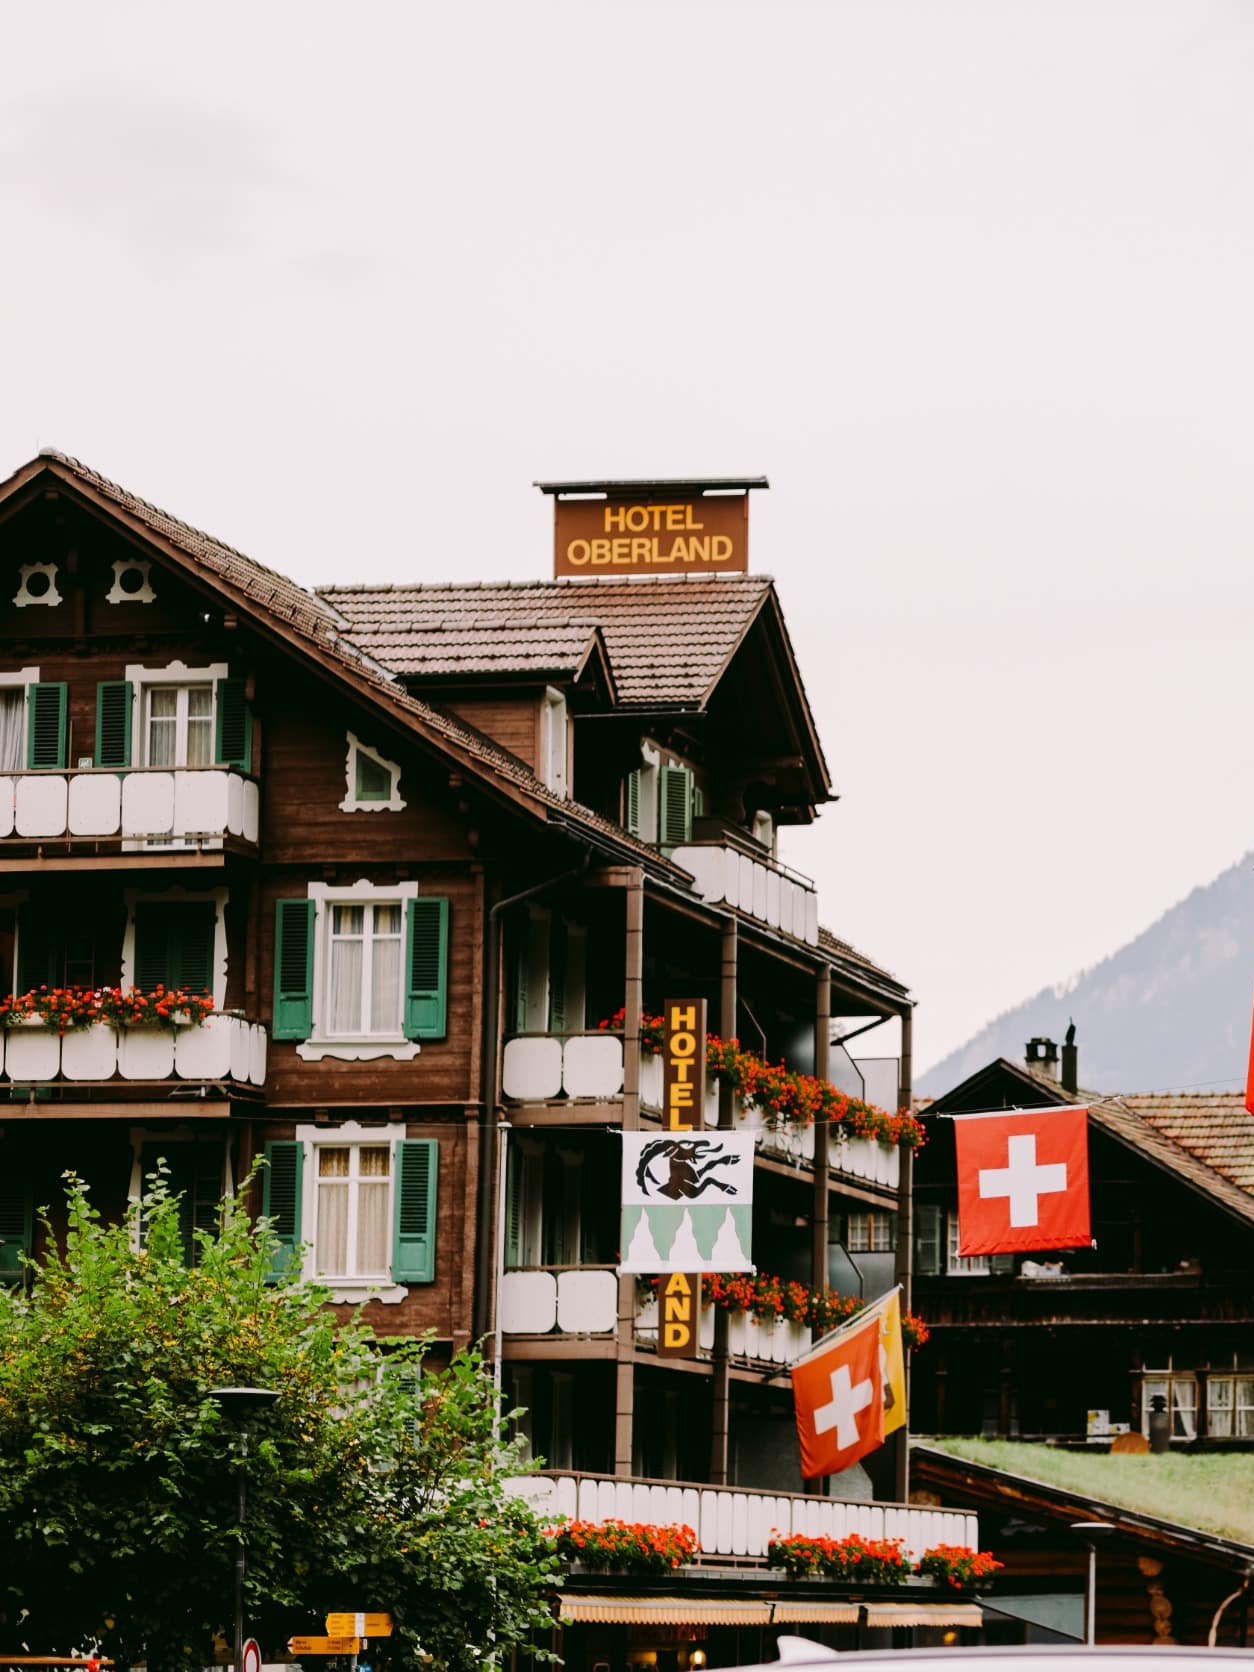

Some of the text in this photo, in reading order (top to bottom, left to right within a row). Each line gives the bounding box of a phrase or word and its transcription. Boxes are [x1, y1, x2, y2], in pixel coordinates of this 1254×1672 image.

[604, 505, 704, 532] HOTEL
[567, 535, 733, 566] OBERLAND
[669, 1006, 697, 1131] HOTEL
